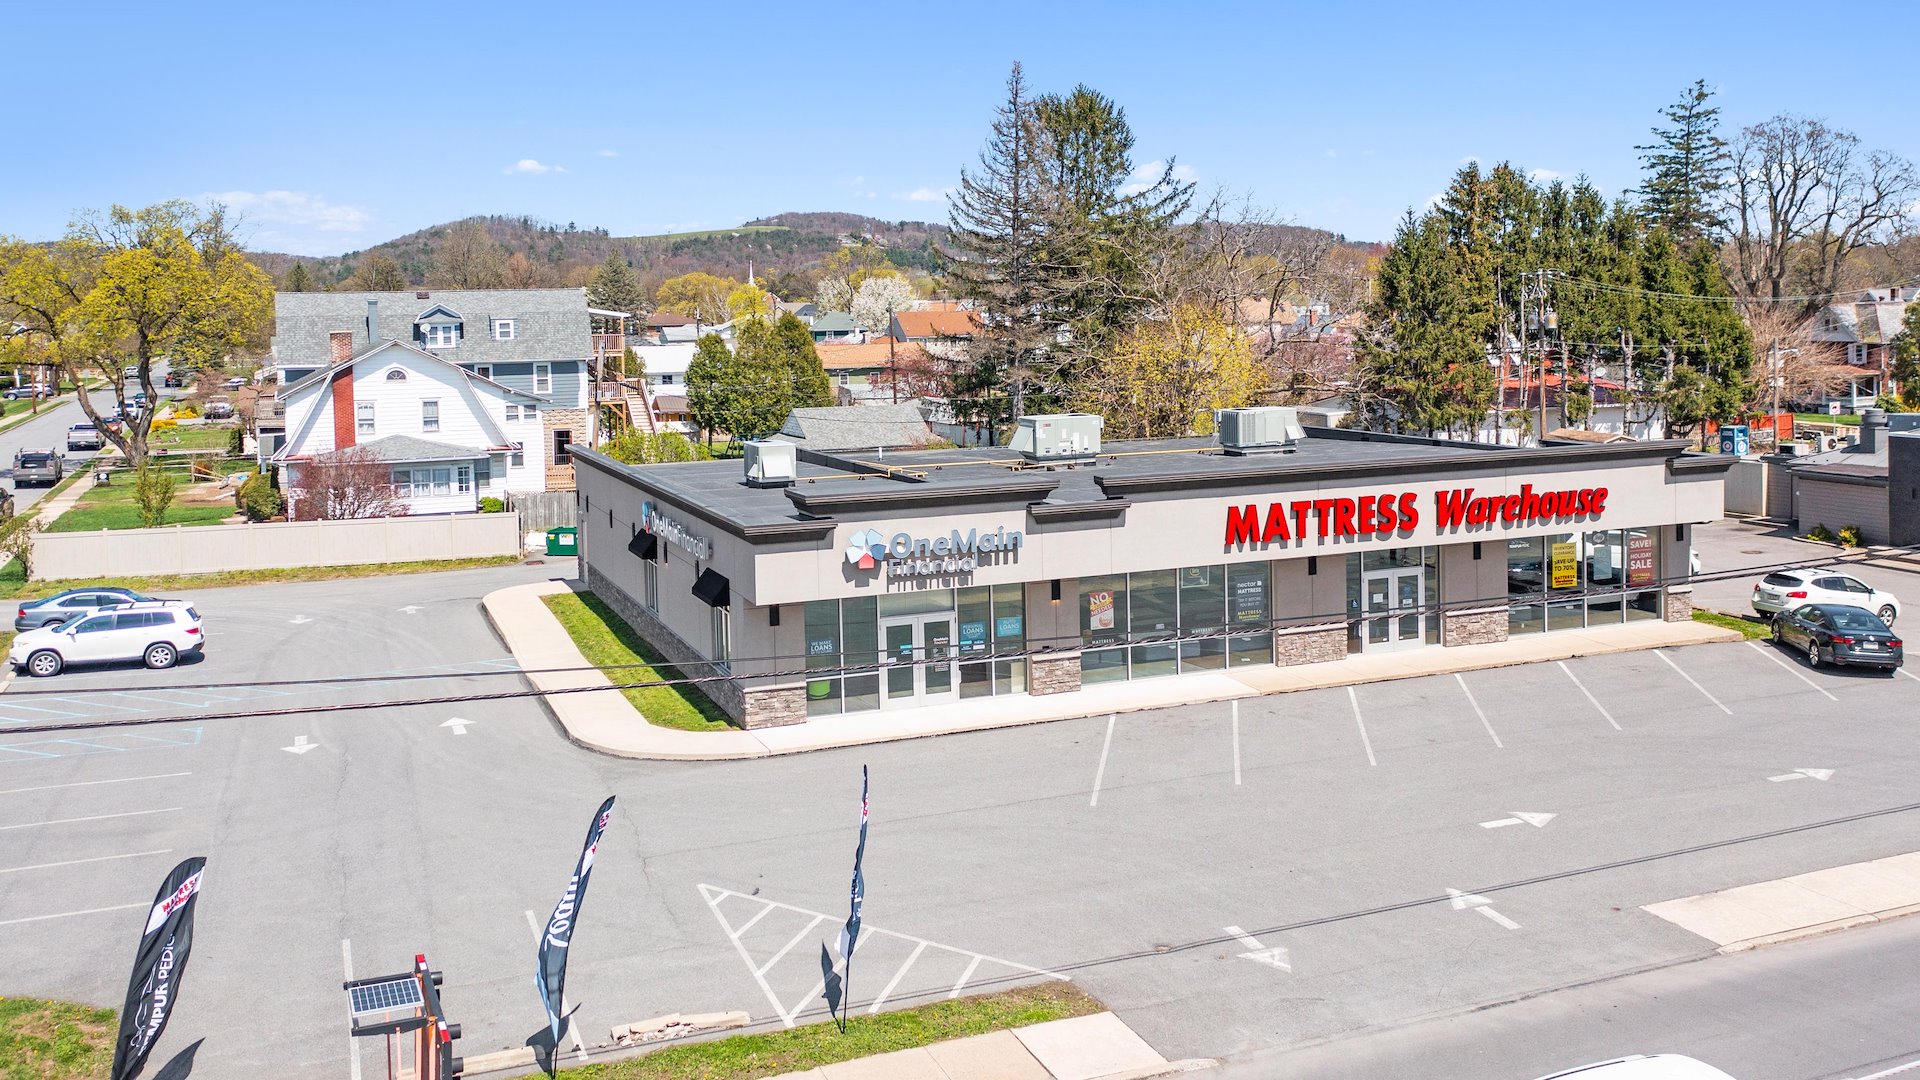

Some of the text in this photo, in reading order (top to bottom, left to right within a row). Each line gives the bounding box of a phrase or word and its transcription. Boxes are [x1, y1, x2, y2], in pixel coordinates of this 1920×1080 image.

[1225, 484, 1608, 545] MATTRESS Warehouse
[889, 525, 1023, 559] OneMain
[1630, 539, 1652, 549] SAVE!
[888, 554, 978, 577] Financial
[1630, 560, 1652, 570] SALE
[1090, 592, 1108, 606] NO
[811, 644, 832, 652] LOANS
